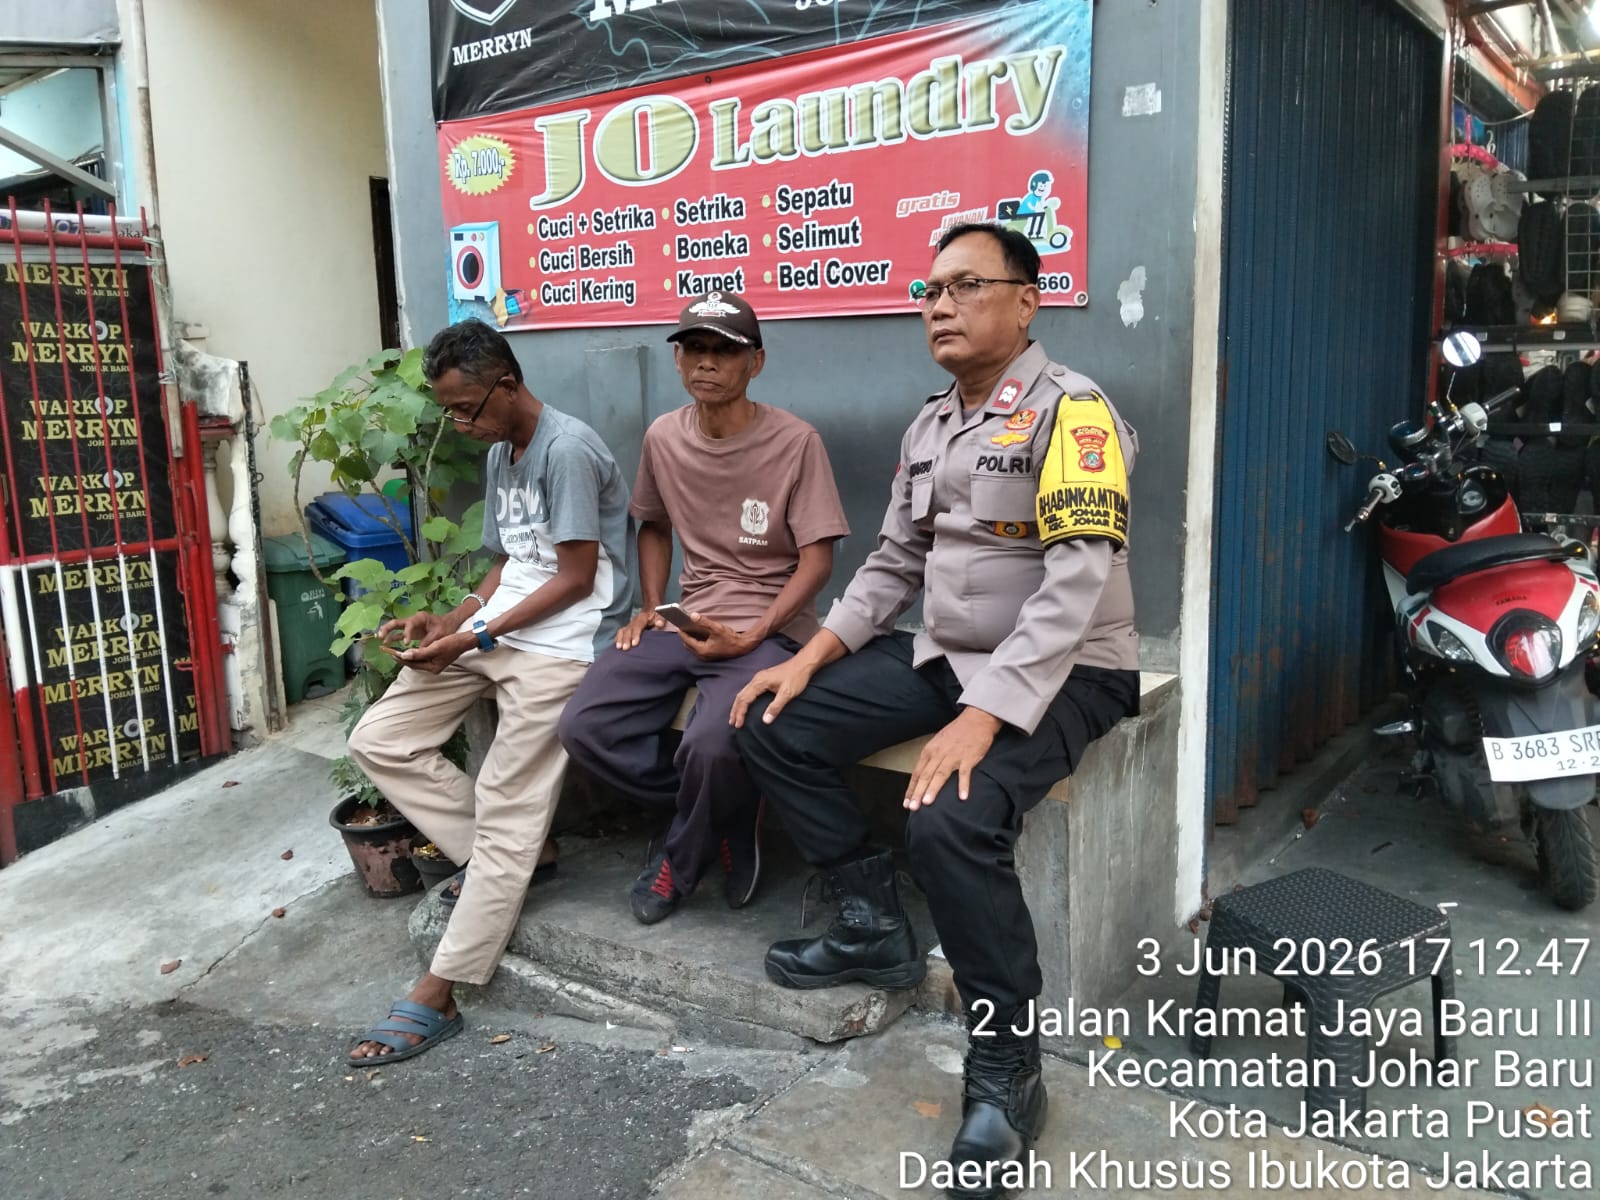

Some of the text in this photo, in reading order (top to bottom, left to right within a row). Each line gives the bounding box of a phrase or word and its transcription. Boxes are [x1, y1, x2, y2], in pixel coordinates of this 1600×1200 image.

[452, 28, 532, 65] MERRYN
[530, 45, 1066, 210] JO Laundry
[454, 153, 470, 184] Rp.
[676, 196, 745, 224] Setrika
[777, 182, 852, 214] Sepatu
[898, 191, 960, 217] gratis
[538, 209, 654, 239] Cuci + Setrika
[778, 220, 860, 250] Selimut
[540, 243, 633, 272] Cuci Bersih
[677, 234, 748, 260] Boneka
[5, 263, 128, 288] MERRYN
[678, 268, 743, 295] Karpet
[779, 260, 890, 289] Bed Cover
[541, 279, 635, 305] Cuci Kering
[21, 320, 122, 341] WARKOP
[12, 342, 134, 363] MERRYN
[29, 396, 128, 417] WARKOP
[22, 418, 138, 441] MERRYN
[976, 456, 1031, 474] POLRI
[37, 469, 135, 492] WARKOP
[29, 490, 147, 518] MERRYN
[1069, 508, 1110, 519] JOHAR
[1072, 517, 1110, 528] JOHAR
[738, 536, 769, 546] SATPAM
[38, 561, 154, 594] MERRYN
[55, 613, 154, 642] WARKOP
[46, 630, 162, 668] MERRYN
[44, 665, 160, 705] MERRYN
[60, 718, 155, 751] WARKOP
[1491, 741, 1504, 761] B
[1511, 736, 1560, 761] 3683
[54, 733, 167, 776] MERRYN
